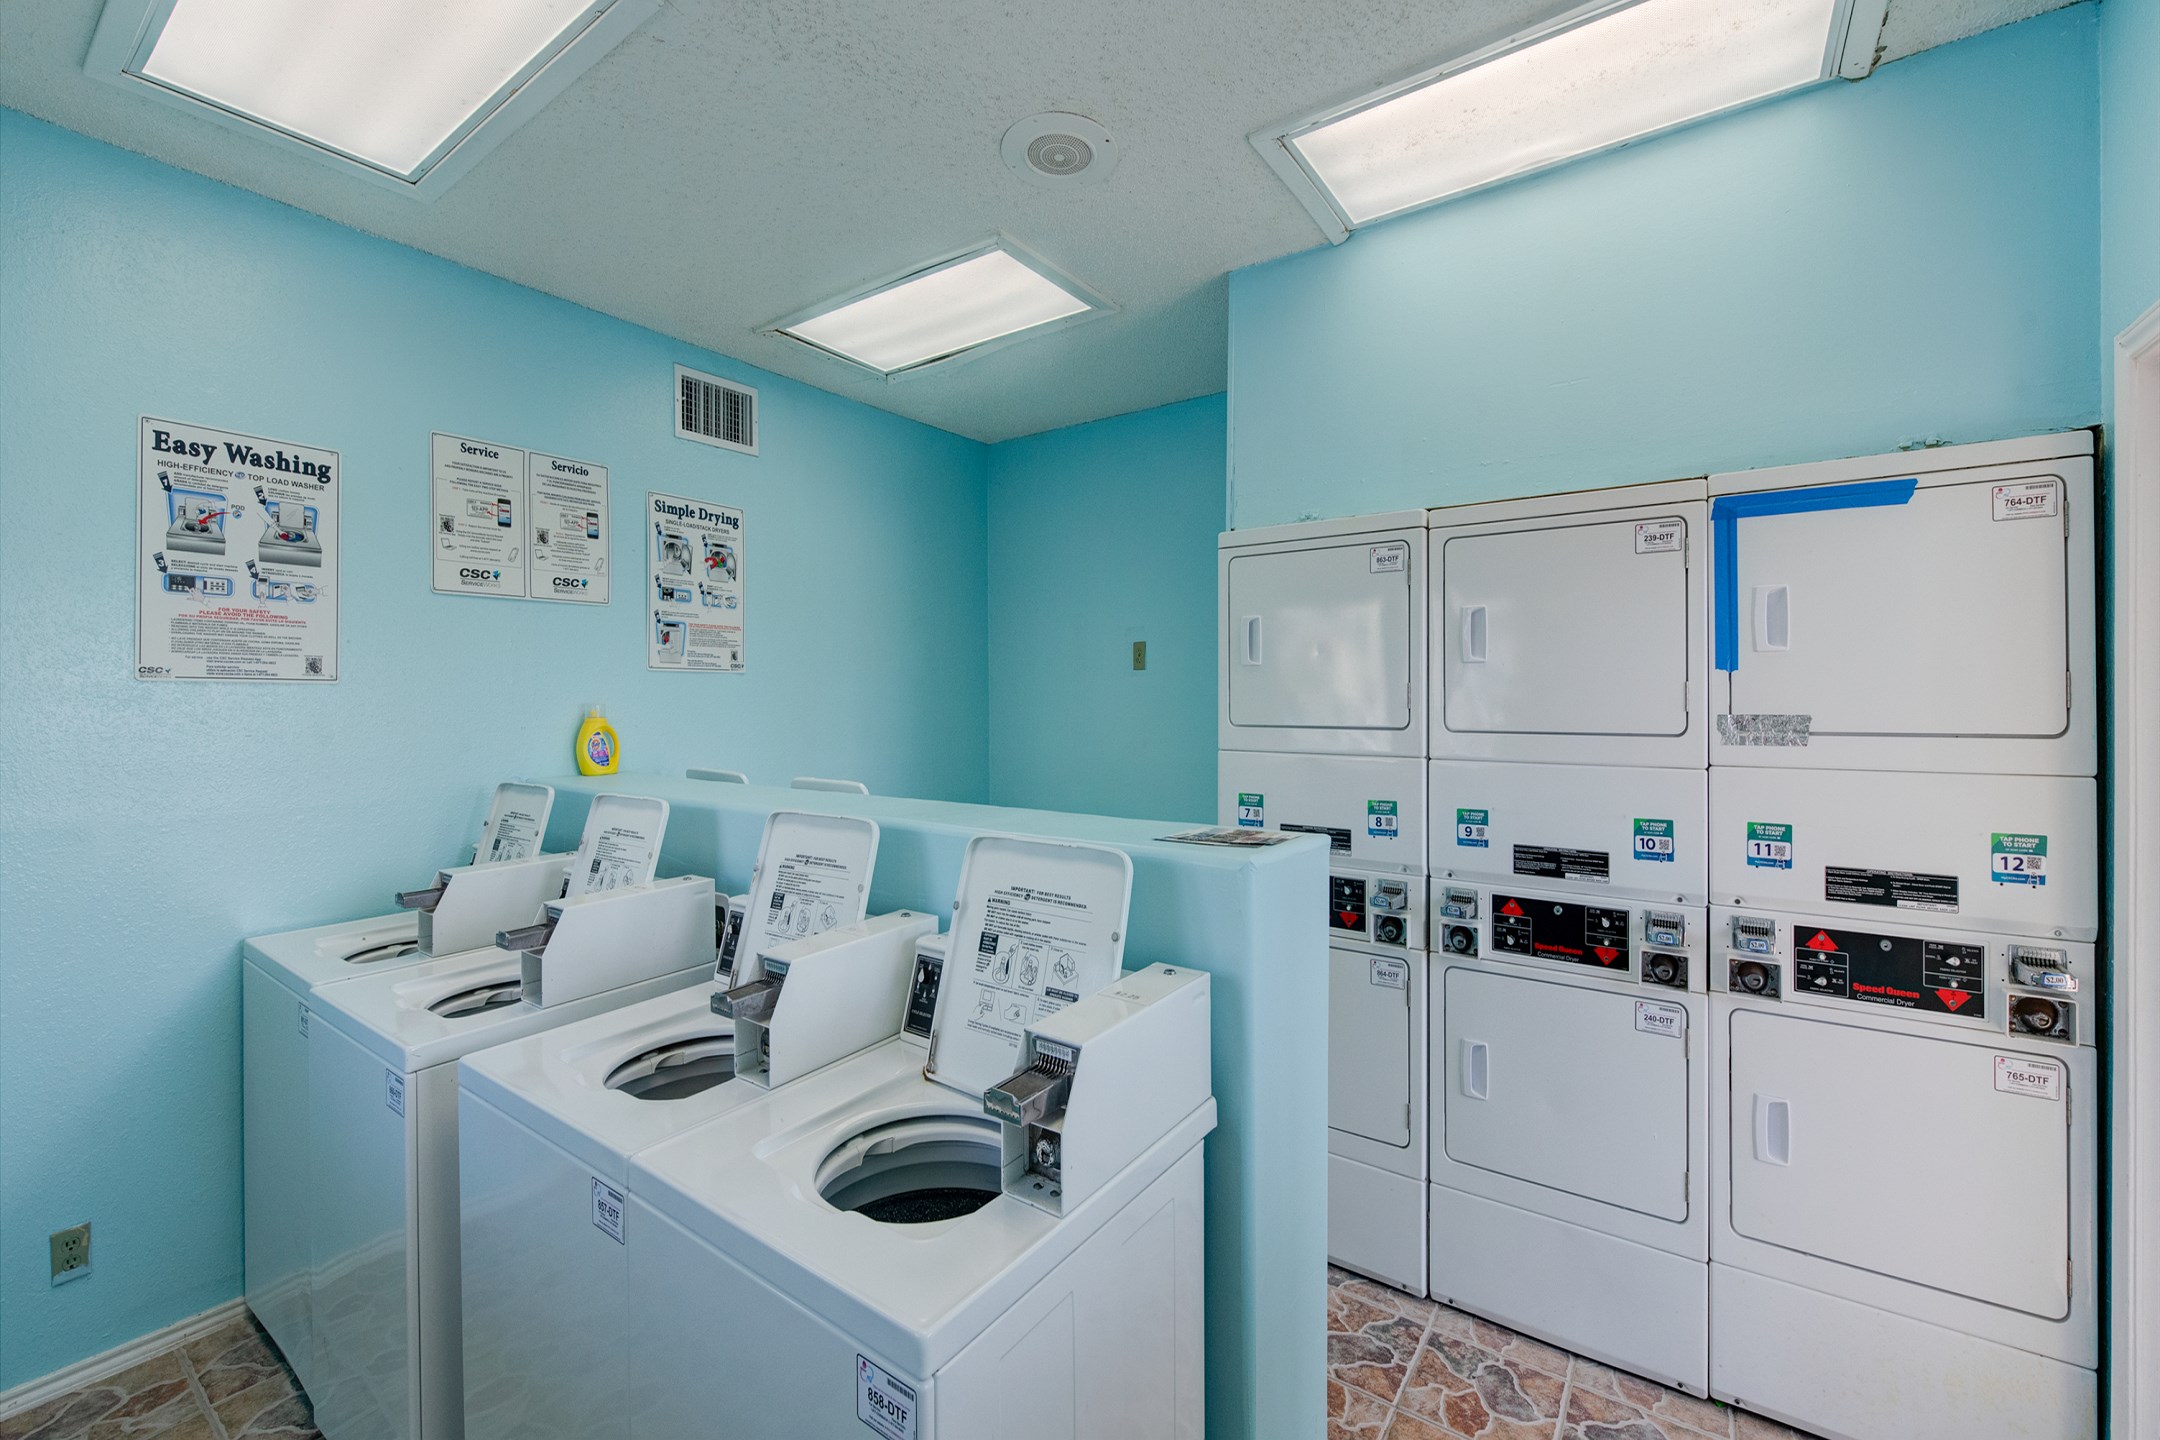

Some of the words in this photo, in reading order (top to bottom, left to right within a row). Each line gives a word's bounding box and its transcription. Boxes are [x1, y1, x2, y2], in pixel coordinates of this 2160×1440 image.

[152, 429, 217, 465] Easy
[224, 442, 331, 484] Washing
[461, 442, 499, 459] Service
[552, 460, 589, 476] Servicio
[158, 460, 234, 478] HIGH-EFFICIENCY
[267, 476, 289, 486] LOAD
[291, 480, 325, 492] WASHER
[2005, 495, 2046, 507] 764-DTF
[655, 500, 695, 520] Simple
[699, 508, 739, 530] Drying
[1644, 533, 1674, 542] 239-DTF
[460, 568, 490, 579] CSC
[552, 577, 579, 587] CSC
[1245, 808, 1250, 817] 7
[1376, 817, 1382, 827] 8
[1465, 826, 1472, 837] 9
[1640, 838, 1655, 850] 10
[1754, 843, 1771, 856] 11
[2001, 856, 2024, 871] 12
[1011, 886, 1035, 894] IMPORTANT!
[1535, 943, 1558, 952] Speed
[1559, 945, 1583, 955] Queen
[1537, 951, 1565, 961] Commercial
[1852, 982, 1884, 994] Speed
[1886, 986, 1920, 999] Queen
[1857, 993, 1895, 1004] Commercial
[1896, 998, 1915, 1007] Dryer
[1644, 1014, 1674, 1024] 240-DTF
[2007, 1071, 2049, 1084] 765-DTF
[868, 1387, 907, 1423] 858-DTF
